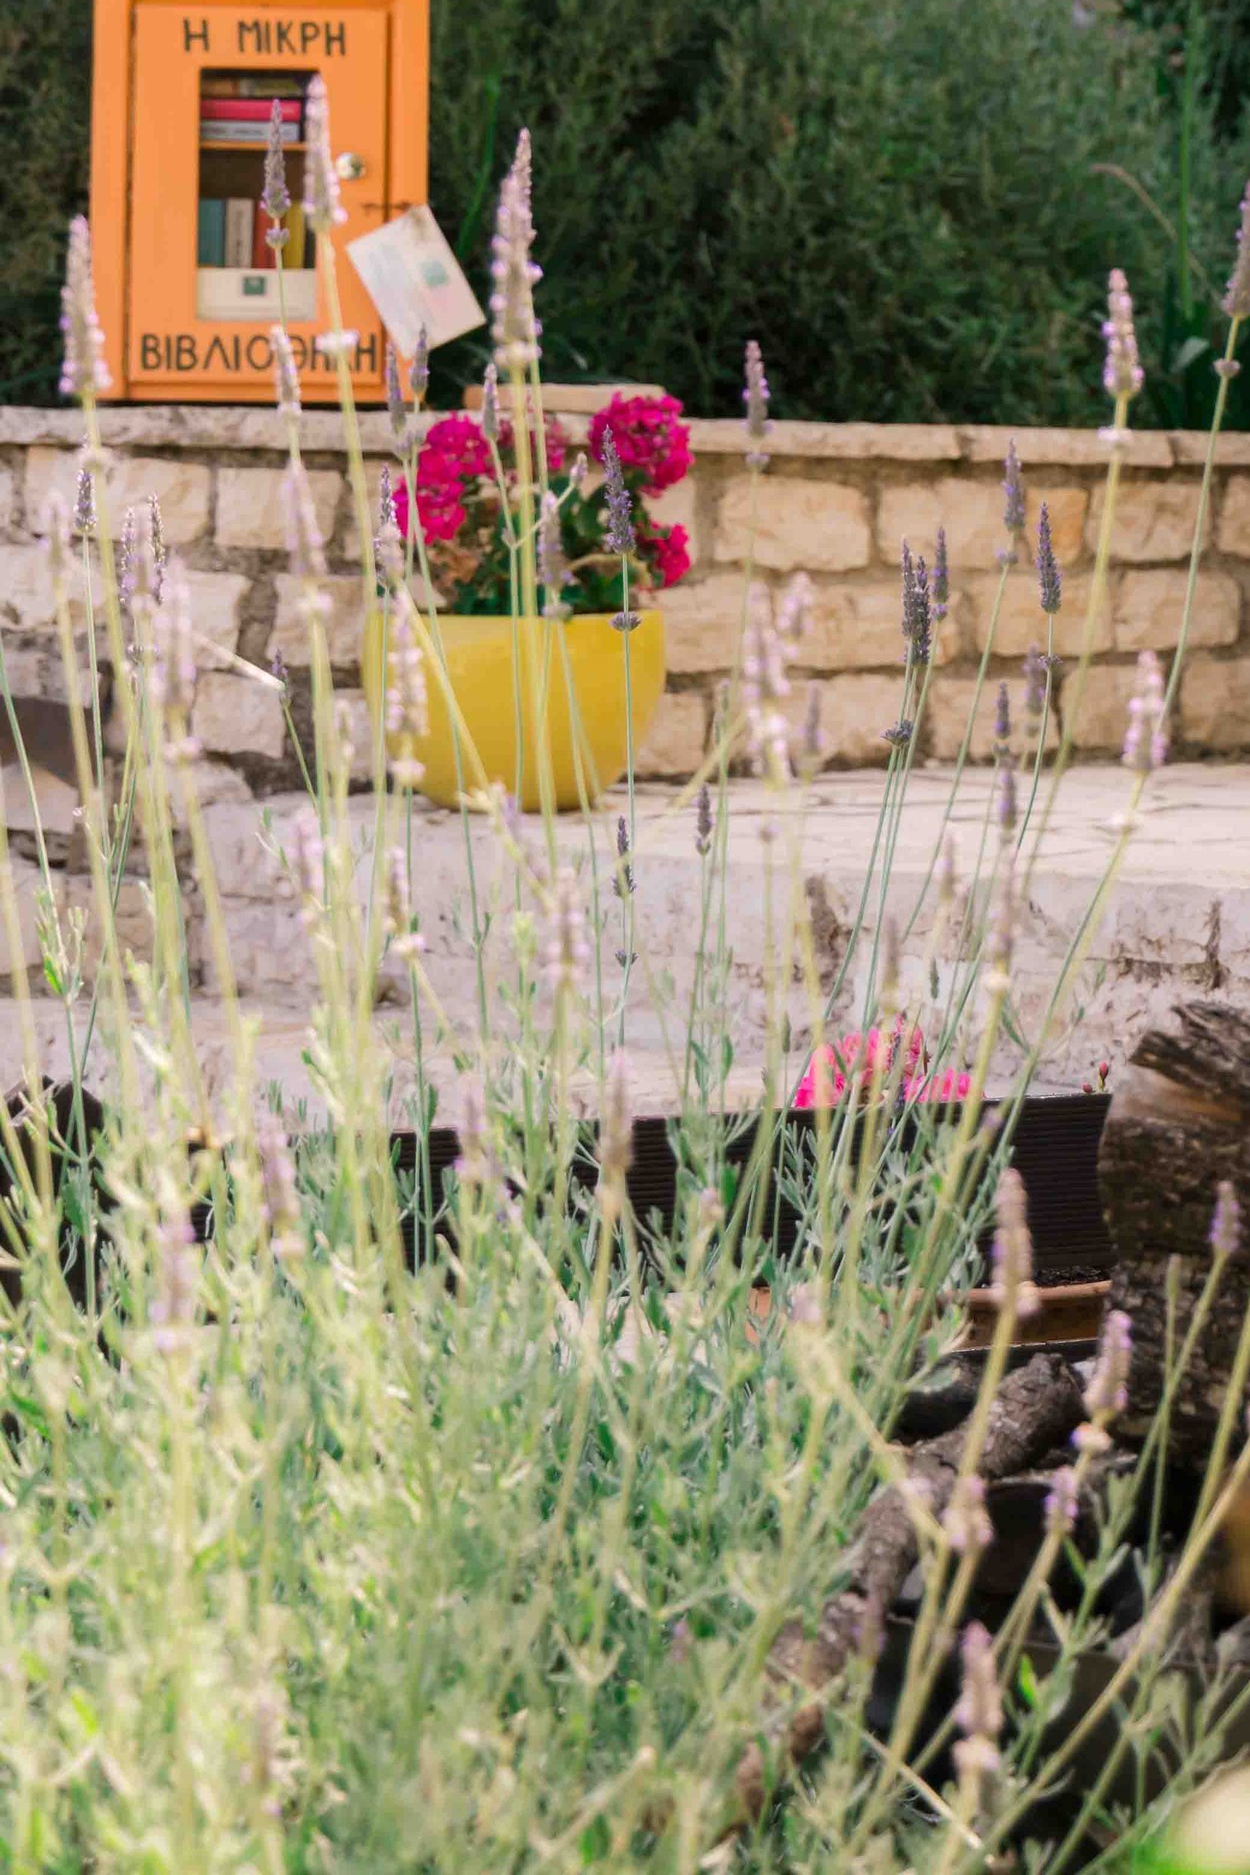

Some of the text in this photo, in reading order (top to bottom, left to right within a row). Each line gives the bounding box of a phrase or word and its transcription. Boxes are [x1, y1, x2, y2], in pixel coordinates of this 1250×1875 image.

[183, 17, 346, 56] Η ΜΙΚΡΗ
[141, 333, 377, 373] ΒΙΒΛΙΟΘΗΗ
